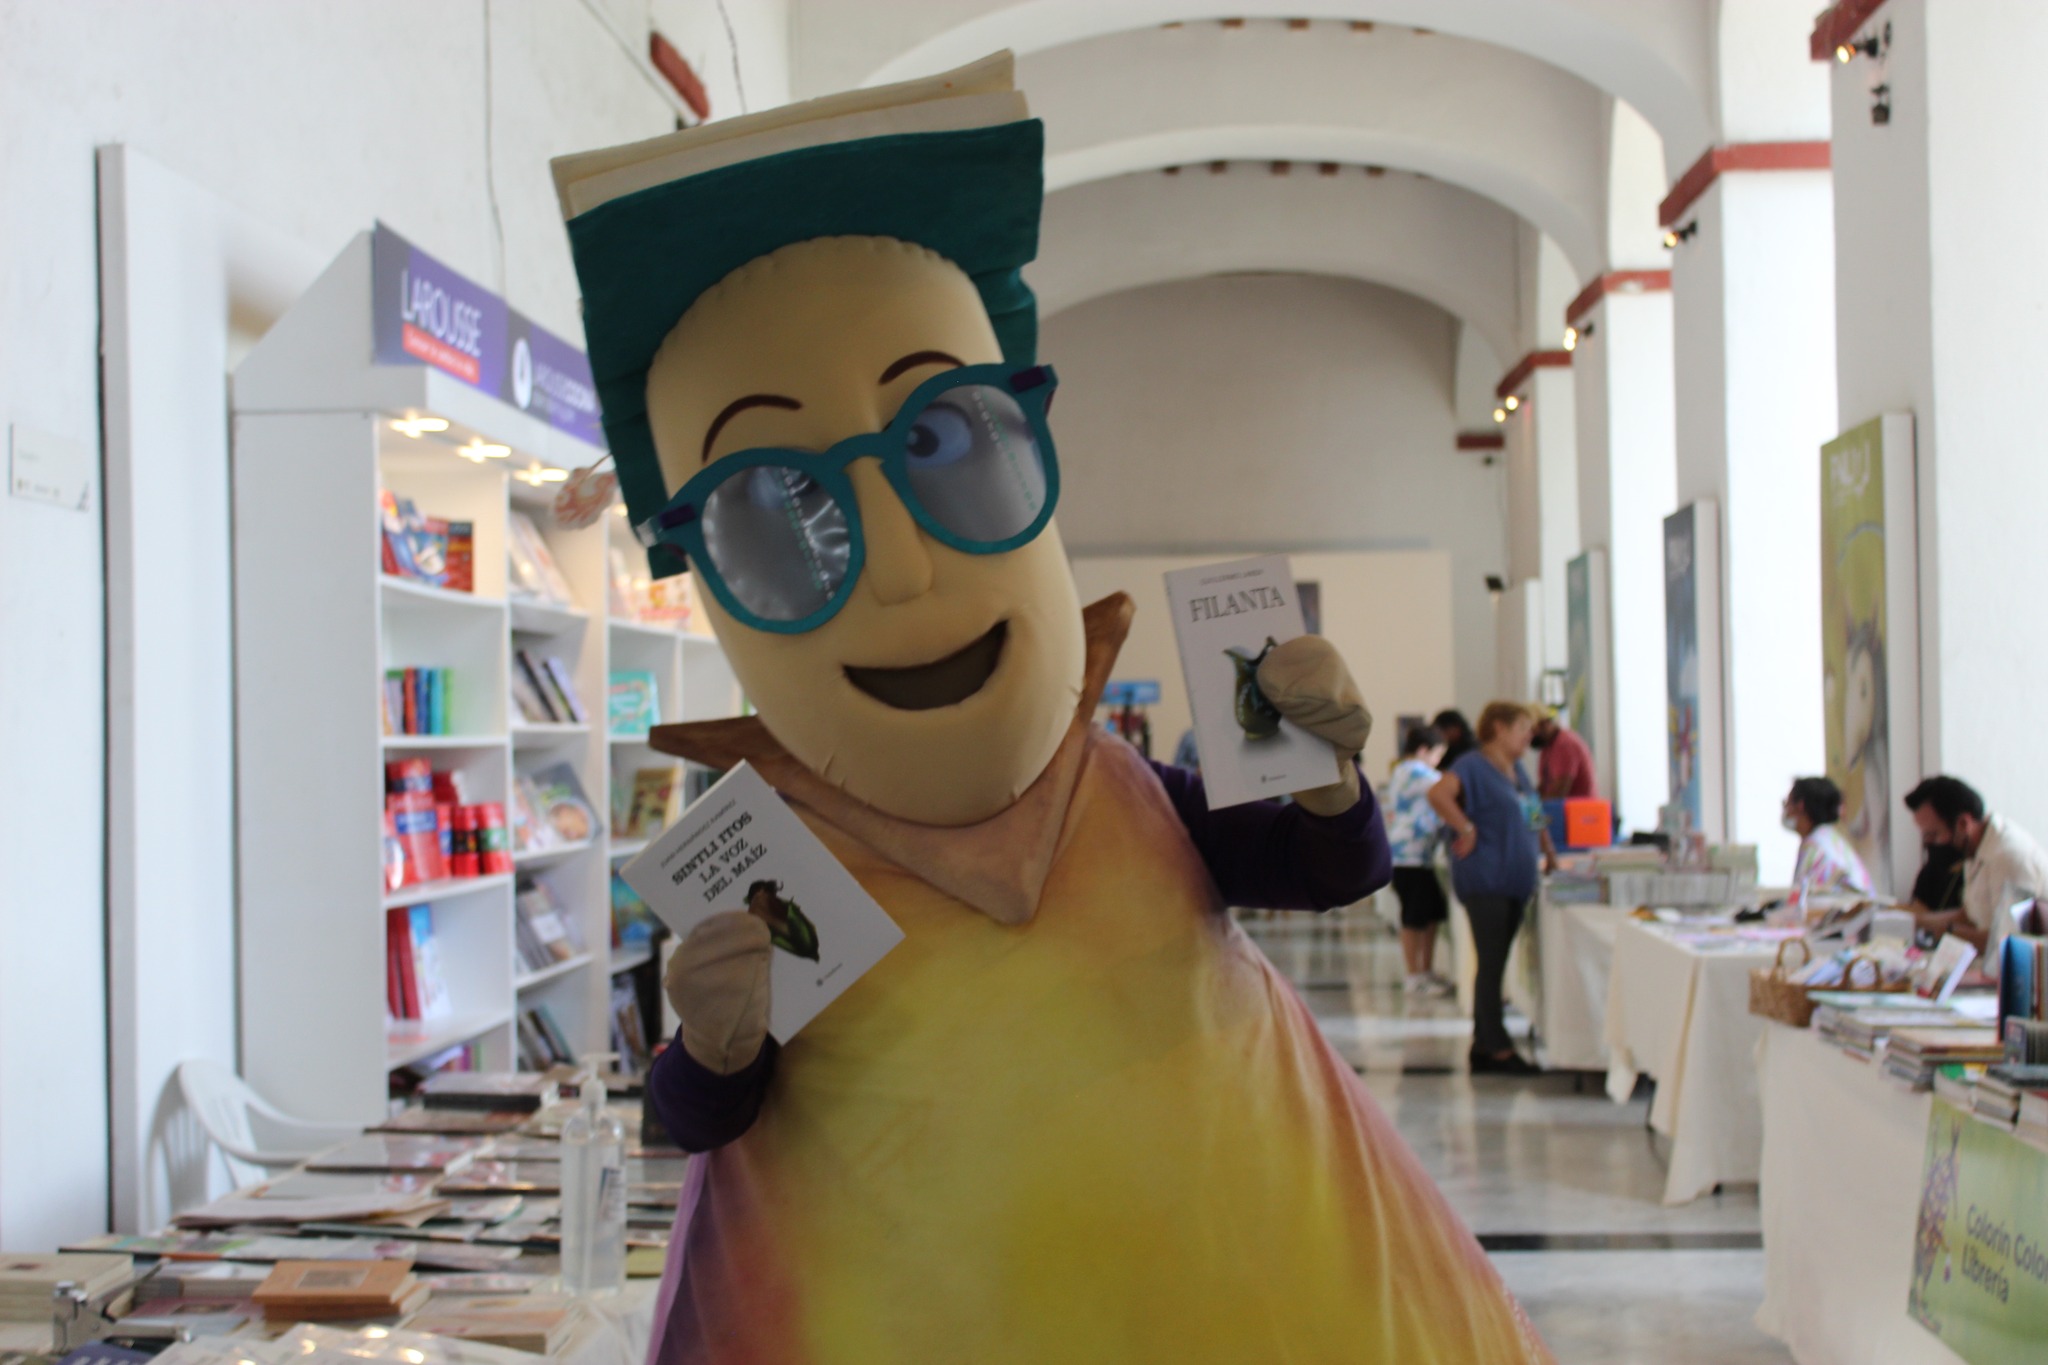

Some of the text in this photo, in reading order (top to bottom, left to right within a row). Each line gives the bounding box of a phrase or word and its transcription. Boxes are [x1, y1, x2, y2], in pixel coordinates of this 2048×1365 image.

[401, 267, 482, 358] LAROUSSE
[1189, 586, 1286, 623] FILANTA
[672, 840, 719, 886] SINTLI
[717, 811, 753, 845] ITOS
[699, 836, 749, 884] LA VOZ
[702, 842, 767, 902] DEL MAÍZ
